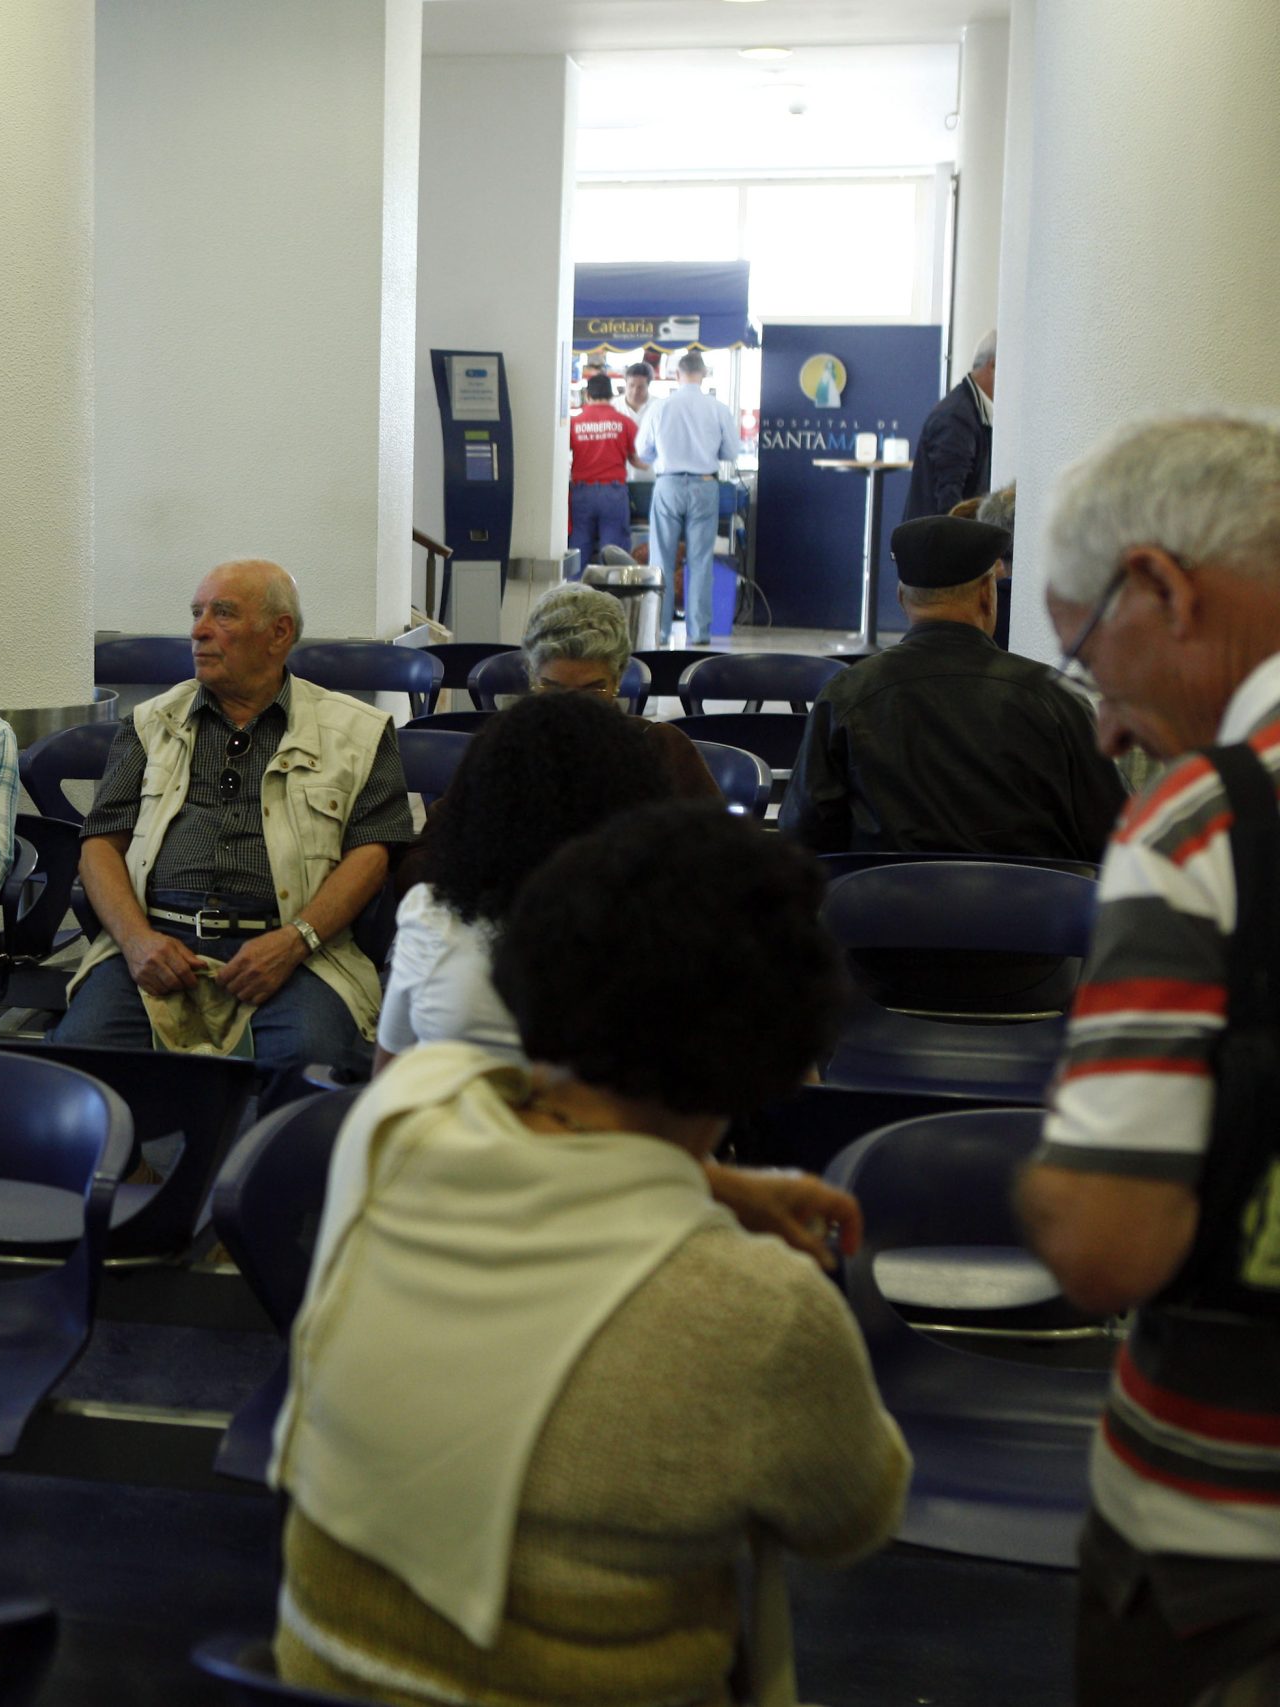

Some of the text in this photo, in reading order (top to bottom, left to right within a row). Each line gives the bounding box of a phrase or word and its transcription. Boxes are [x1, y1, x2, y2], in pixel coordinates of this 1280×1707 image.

[588, 319, 654, 333] Cafetaria
[575, 421, 623, 433] BOMBEIROS
[763, 419, 899, 429] HOSPITAL DE
